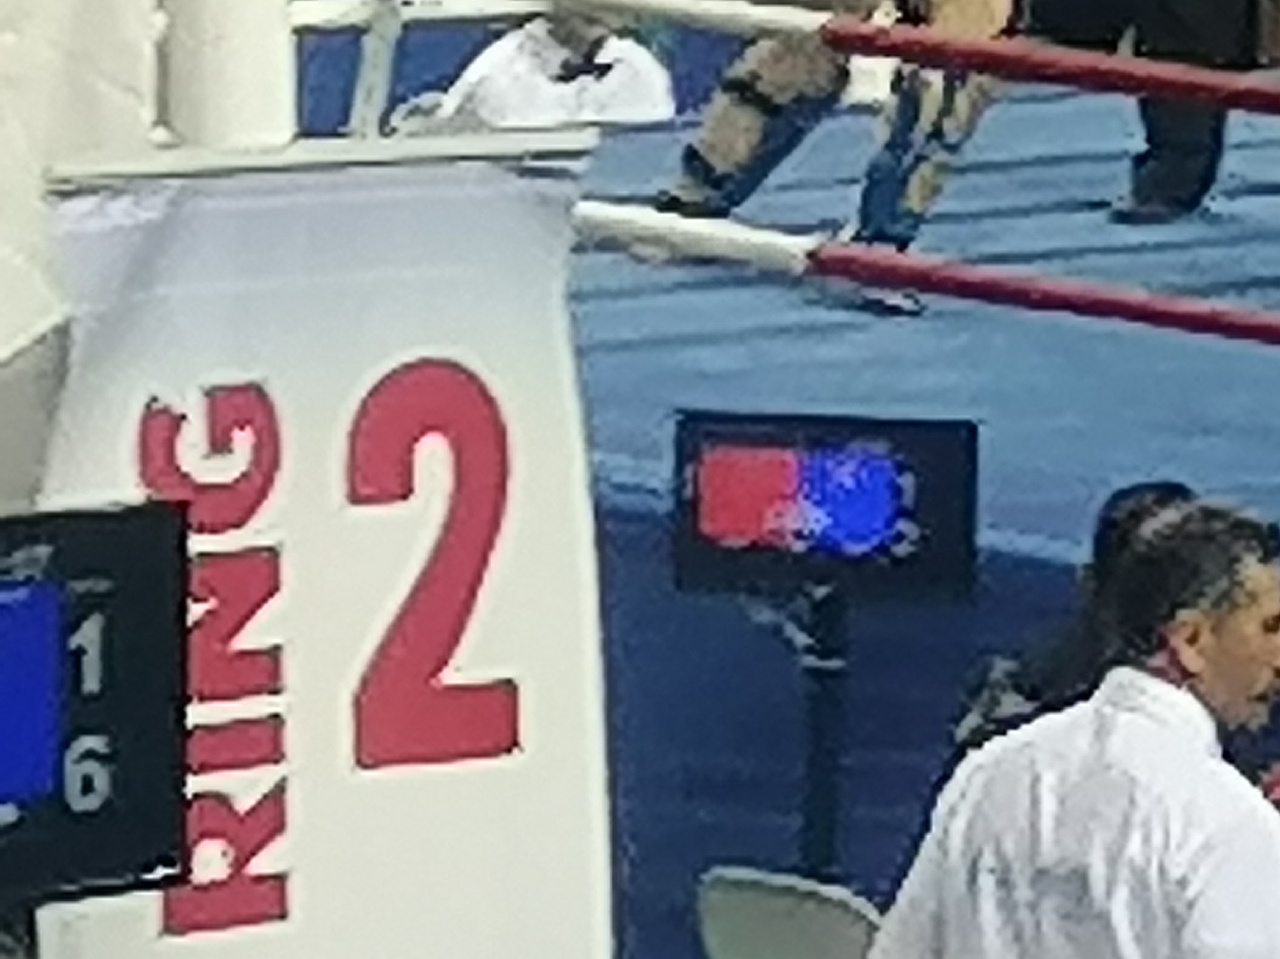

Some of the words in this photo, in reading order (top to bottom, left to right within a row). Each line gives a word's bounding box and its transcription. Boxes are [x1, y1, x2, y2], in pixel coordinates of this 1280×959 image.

[67, 612, 105, 695] 1
[138, 382, 287, 935] RING
[348, 357, 519, 769] 2
[63, 735, 110, 813] 6
